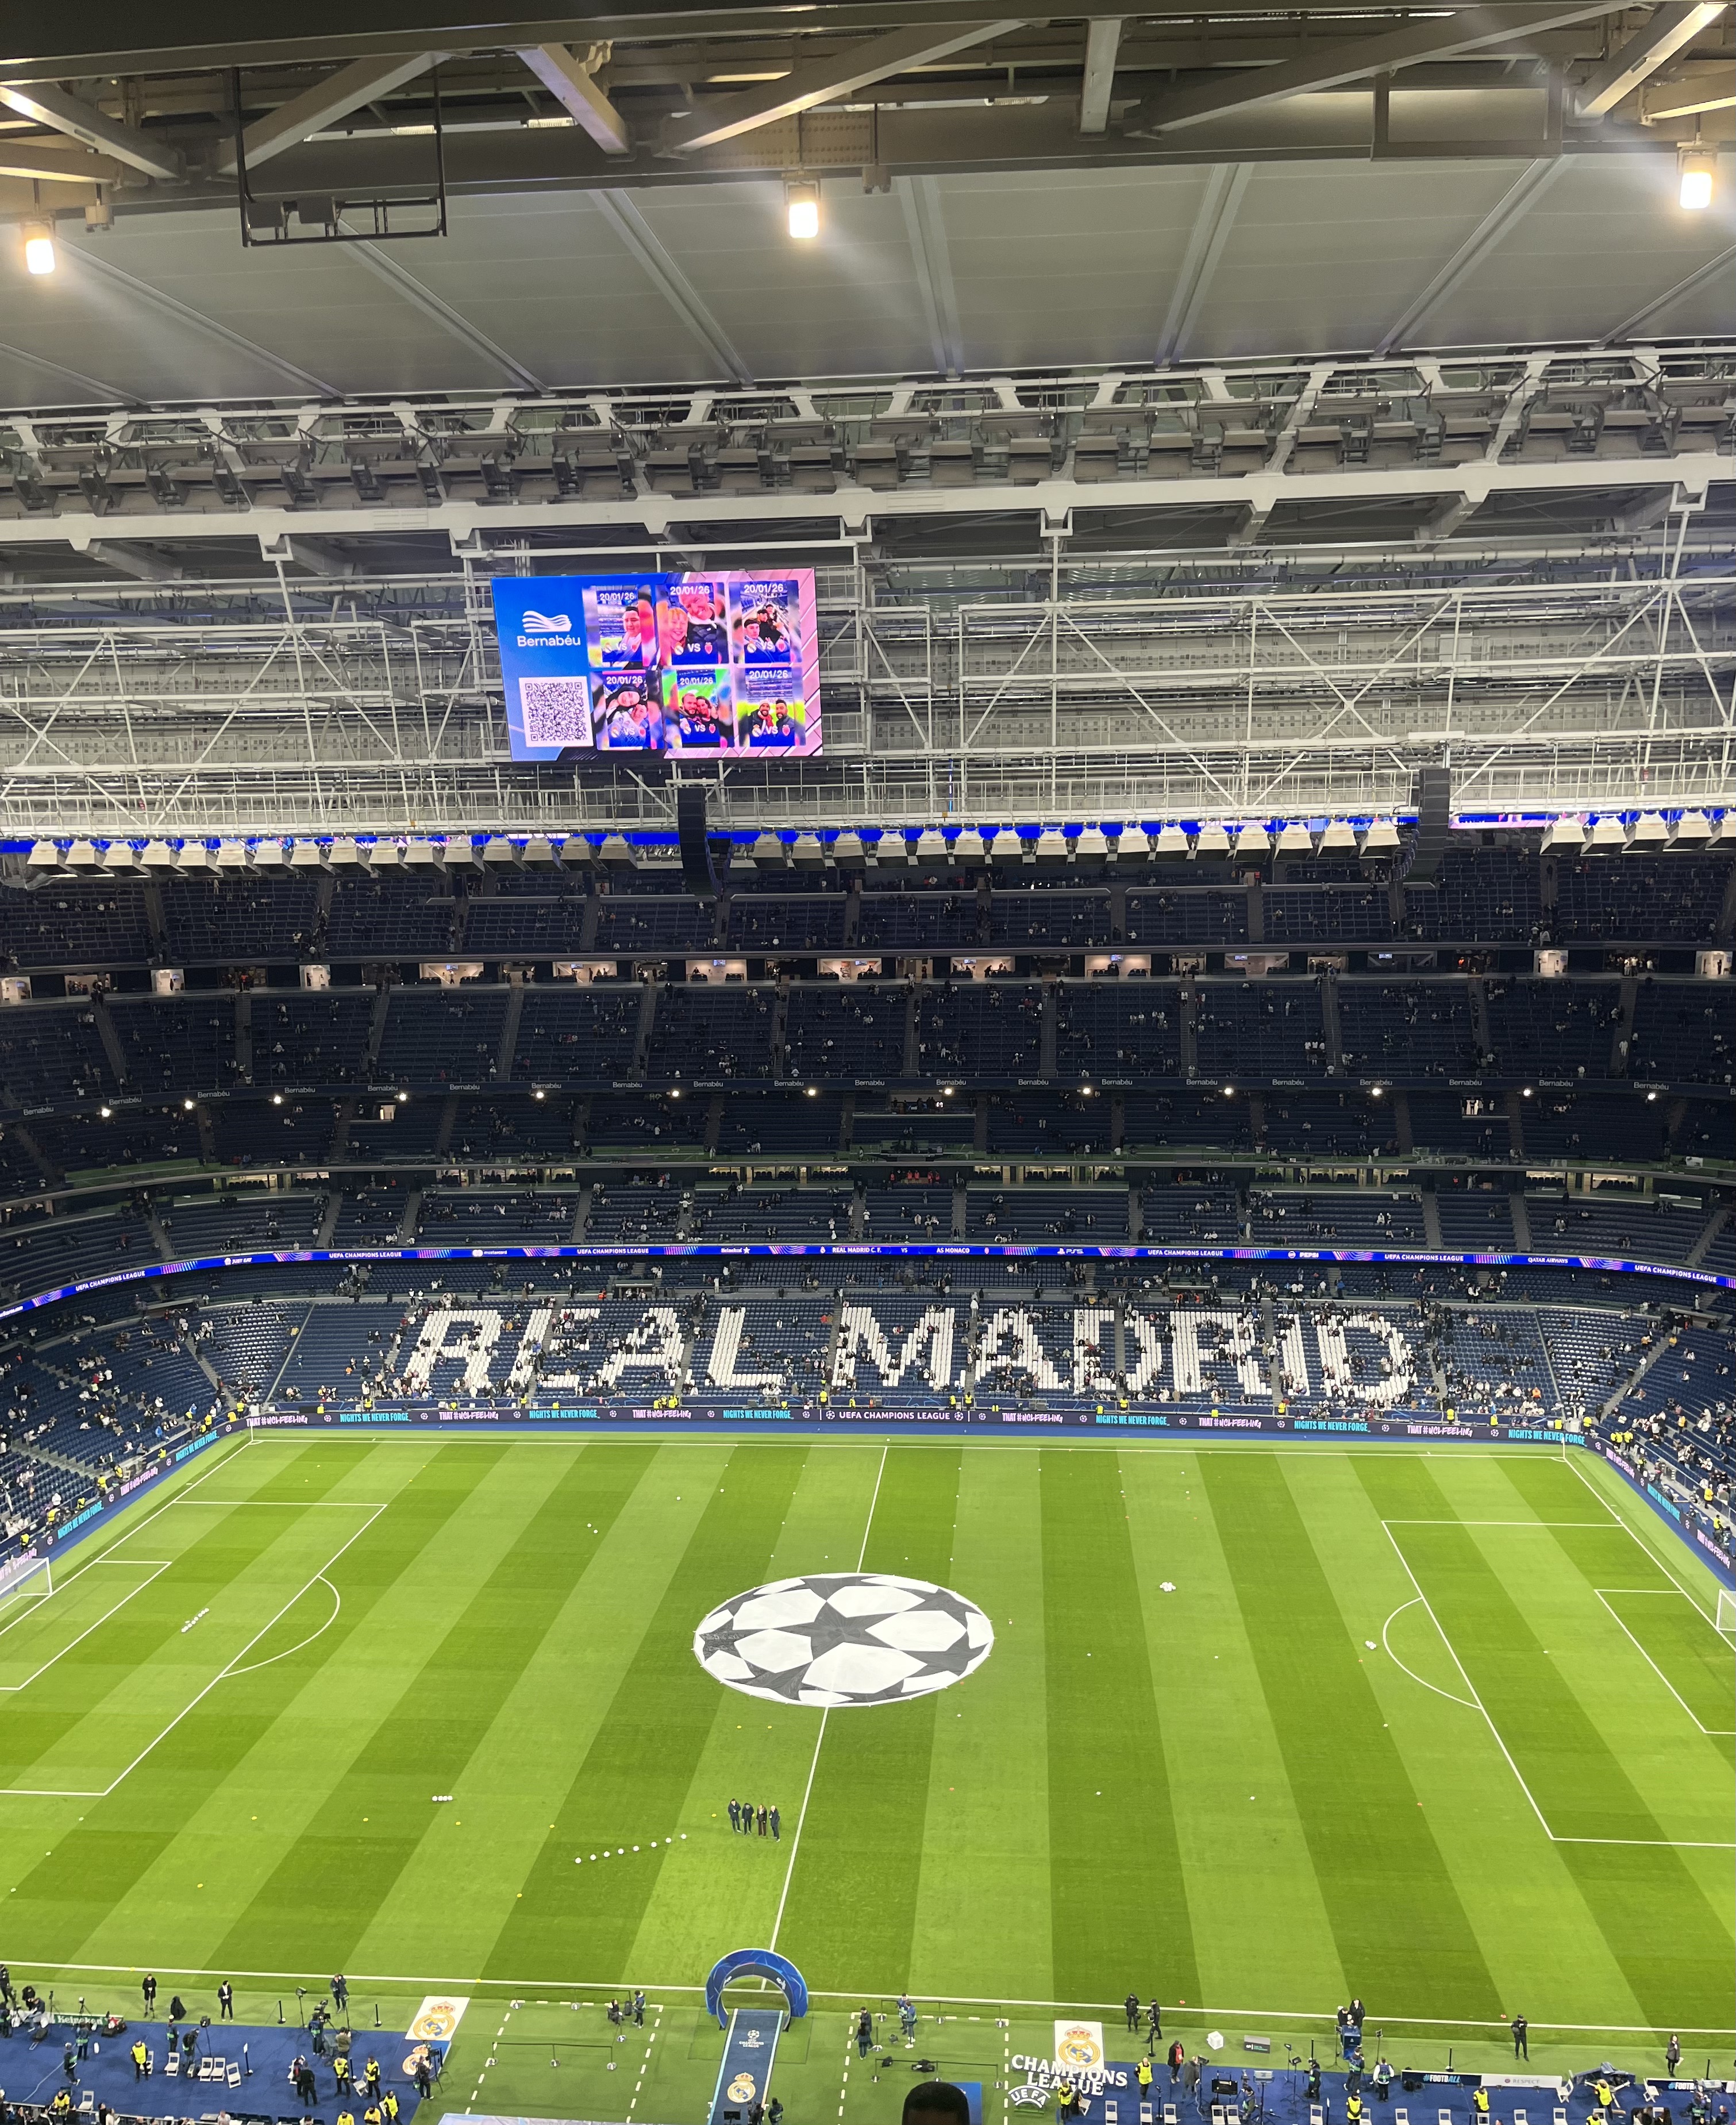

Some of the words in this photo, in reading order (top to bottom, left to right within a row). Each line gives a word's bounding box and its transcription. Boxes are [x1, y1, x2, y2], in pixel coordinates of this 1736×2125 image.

[670, 586, 710, 595] 20/01/26
[744, 584, 783, 594] 20/01/26
[600, 592, 634, 601] 20/01/26
[517, 634, 581, 648] Bernabéu
[687, 643, 701, 652] VS
[749, 670, 788, 679] 20/01/26
[606, 676, 642, 685] 20/01/26
[680, 677, 713, 685] 20/01/26
[1634, 1081, 1669, 1091] Bernabéu
[197, 1090, 230, 1098] Bernabéu
[109, 1096, 141, 1106] Bernabéu
[24, 1107, 54, 1116] Bernabéu
[1653, 1266, 1691, 1278] CHAMPIONS
[1692, 1273, 1717, 1283] LEAGUE
[76, 1283, 88, 1291] UEFA
[90, 1275, 122, 1288] CHAMPIONS
[122, 1271, 145, 1280] LEAGUE
[340, 1414, 362, 1422] NIGHTS
[363, 1414, 371, 1422] WE
[371, 1414, 390, 1422] NEVER
[439, 1411, 453, 1420] THAT
[529, 1410, 551, 1419] NIGHTS
[551, 1410, 559, 1418] WE
[560, 1410, 578, 1418] NEVER
[632, 1410, 646, 1418] THAT
[723, 1410, 744, 1418] NIGHTS
[745, 1410, 753, 1418] WE
[754, 1410, 772, 1418] NEVER
[864, 1411, 914, 1419] CHAMPIONS
[1002, 1412, 1017, 1422] THAT
[247, 1418, 261, 1427] THAT
[1096, 1415, 1118, 1424] NIGHTS
[1119, 1415, 1127, 1424] WE
[1128, 1416, 1147, 1425] NEVER
[1199, 1417, 1213, 1426] THAT
[1294, 1420, 1317, 1430] NIGHTS
[1318, 1421, 1327, 1430] WE
[1327, 1421, 1347, 1430] NEVER
[1407, 1425, 1422, 1434] THAT
[1508, 1429, 1532, 1439] NIGHTS
[1533, 1430, 1543, 1439] WE
[1543, 1431, 1564, 1442] NEVER
[1011, 2054, 1127, 2087] CHAMPIONS
[1423, 2074, 1461, 2084] #FOOTBALL
[1027, 2072, 1104, 2096] LEAGUE
[1668, 2082, 1695, 2091] #FOOTB
[1011, 2089, 1046, 2106] UEFA
